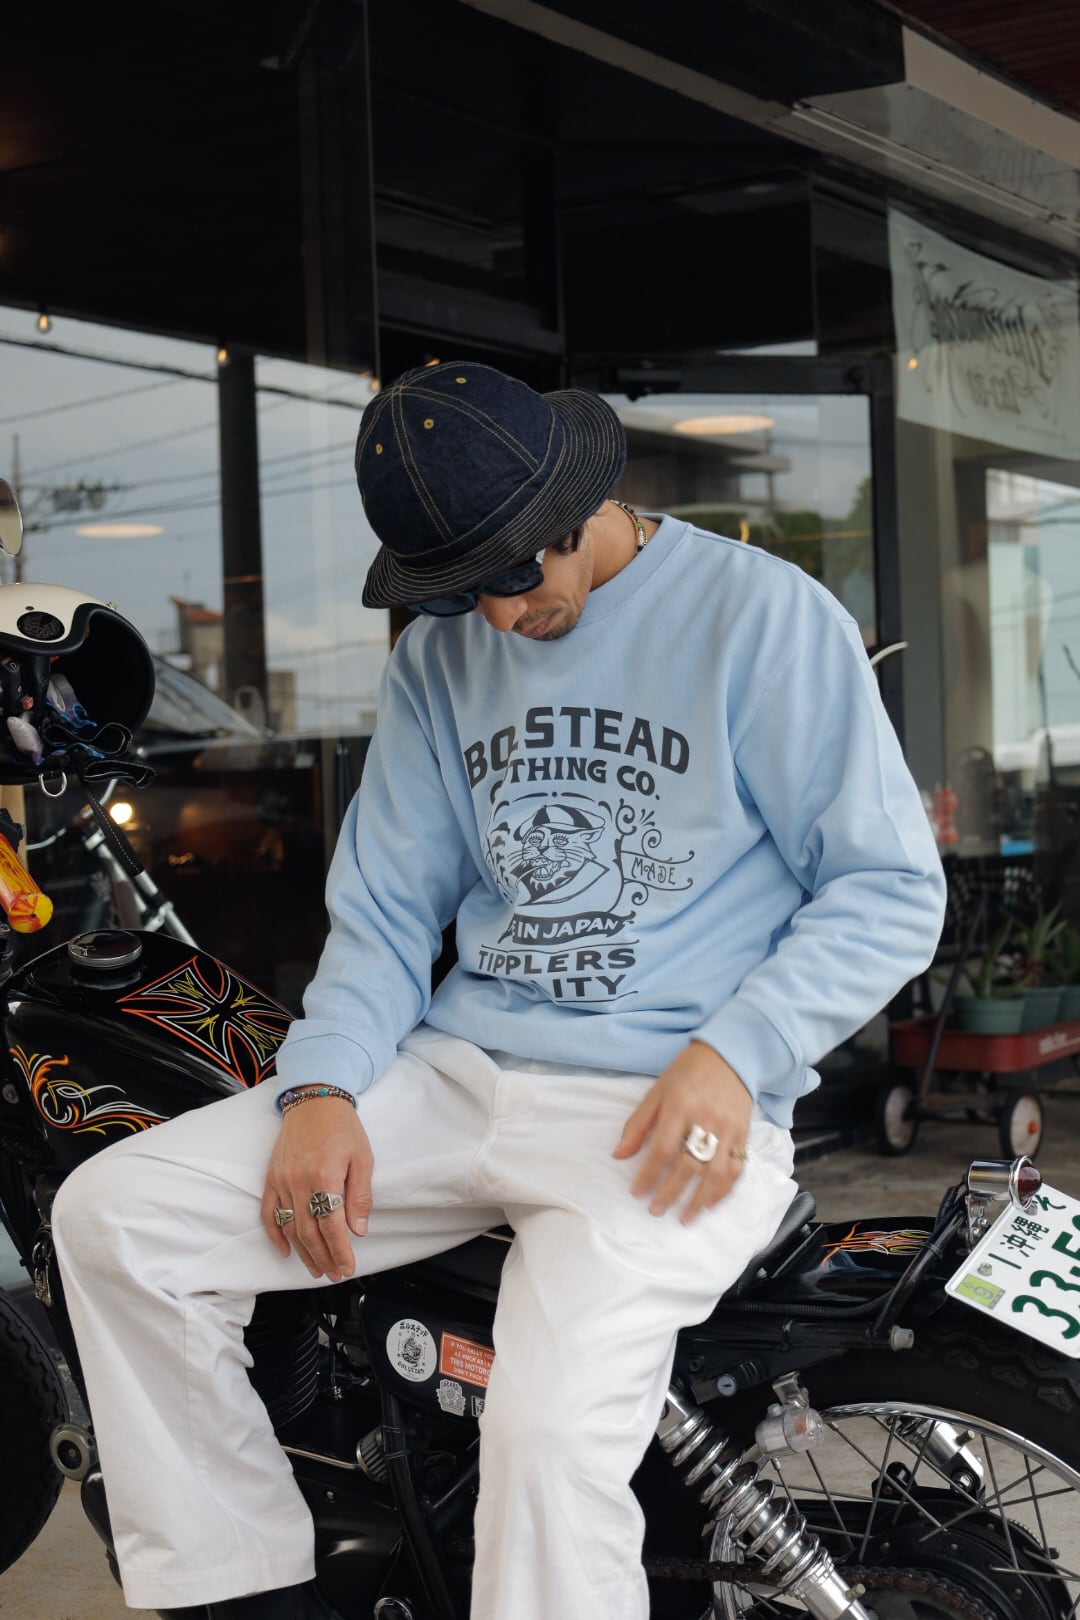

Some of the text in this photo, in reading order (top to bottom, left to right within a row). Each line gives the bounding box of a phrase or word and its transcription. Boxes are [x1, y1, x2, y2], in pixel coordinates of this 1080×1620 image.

[464, 706, 690, 789] BOSTEAD
[616, 765, 660, 801] CO.
[632, 856, 676, 885] MADE
[517, 921, 539, 939] IN
[542, 917, 619, 939] JAPAN
[478, 948, 636, 975] TIPPLERS
[552, 974, 627, 998] ITY
[450, 1356, 464, 1368] THIS
[465, 1362, 491, 1376] MOTORC
